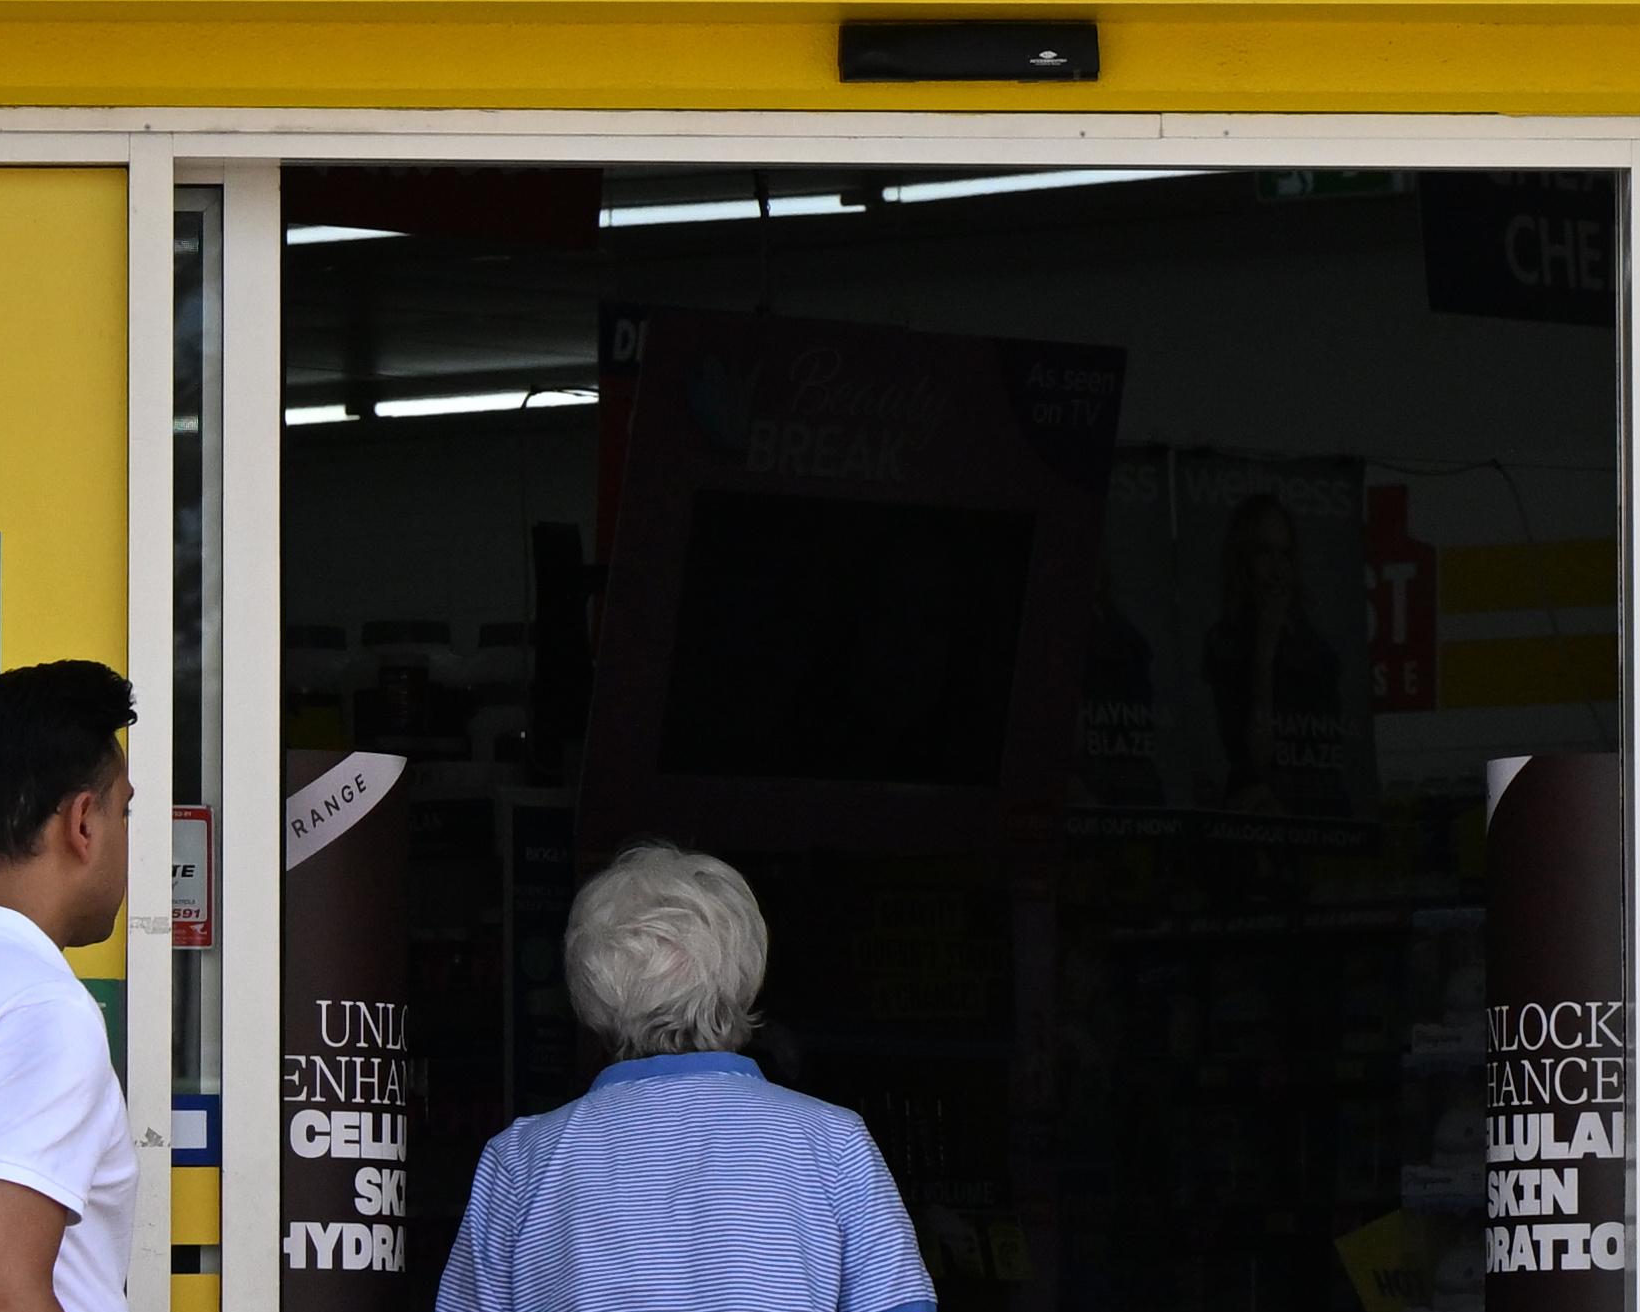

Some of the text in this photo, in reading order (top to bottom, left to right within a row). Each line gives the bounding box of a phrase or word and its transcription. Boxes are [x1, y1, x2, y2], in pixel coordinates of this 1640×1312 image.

[1504, 214, 1616, 293] CHE
[1071, 399, 1104, 425] TV
[746, 418, 906, 481] BREAK
[291, 773, 367, 839] RANGE
[1486, 1111, 1624, 1163] LLULA
[1487, 1167, 1579, 1219] SKIN
